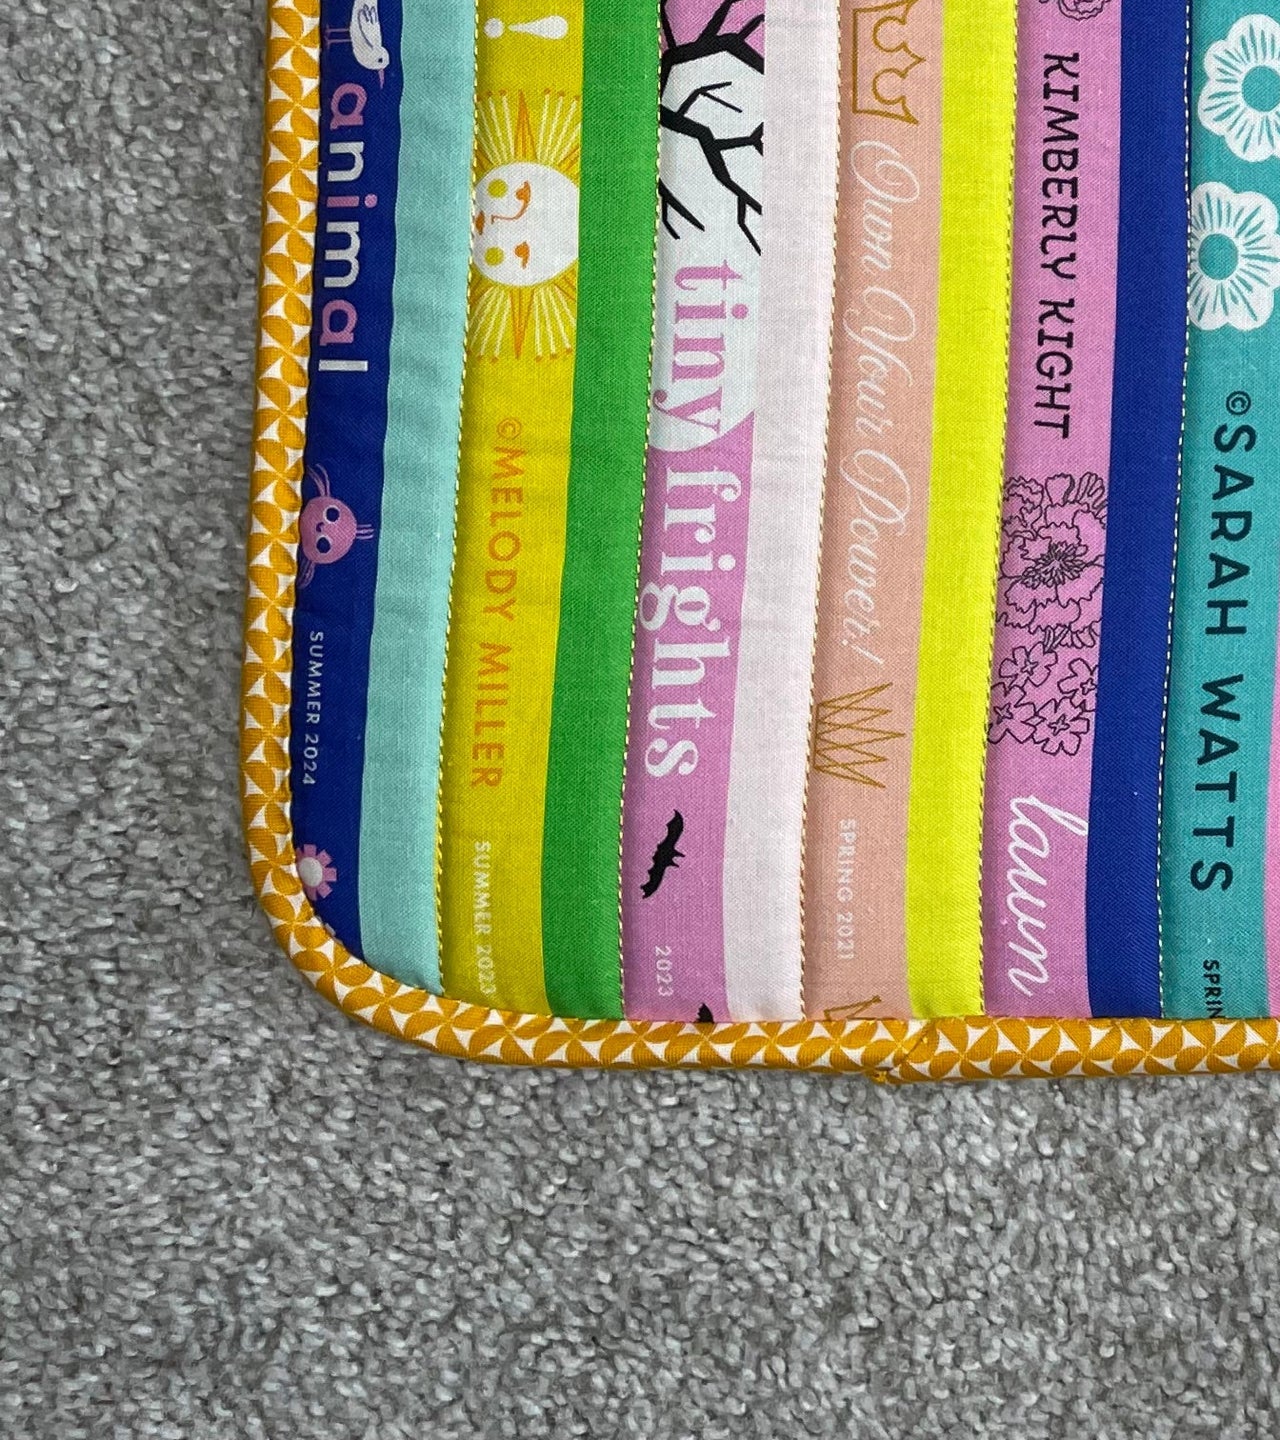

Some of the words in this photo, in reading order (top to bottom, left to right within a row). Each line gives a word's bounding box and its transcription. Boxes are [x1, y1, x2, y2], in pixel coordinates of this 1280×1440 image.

[318, 82, 376, 371] animal
[850, 140, 921, 273] Own
[1040, 53, 1080, 283] KIMBERLY
[652, 260, 748, 438] tiny
[854, 286, 917, 436] Your
[1034, 299, 1072, 439] KIGHT
[639, 465, 741, 778] frights
[839, 449, 912, 665] Power!
[305, 631, 324, 724] SUMMER
[471, 642, 508, 789] MILLER
[301, 734, 320, 785] 2024
[1190, 676, 1244, 892] WATTS
[472, 841, 494, 936] SUMMER
[838, 819, 856, 904] SPRING
[1004, 794, 1088, 996] lawn
[654, 946, 674, 998] 2023
[839, 912, 854, 960] 2021
